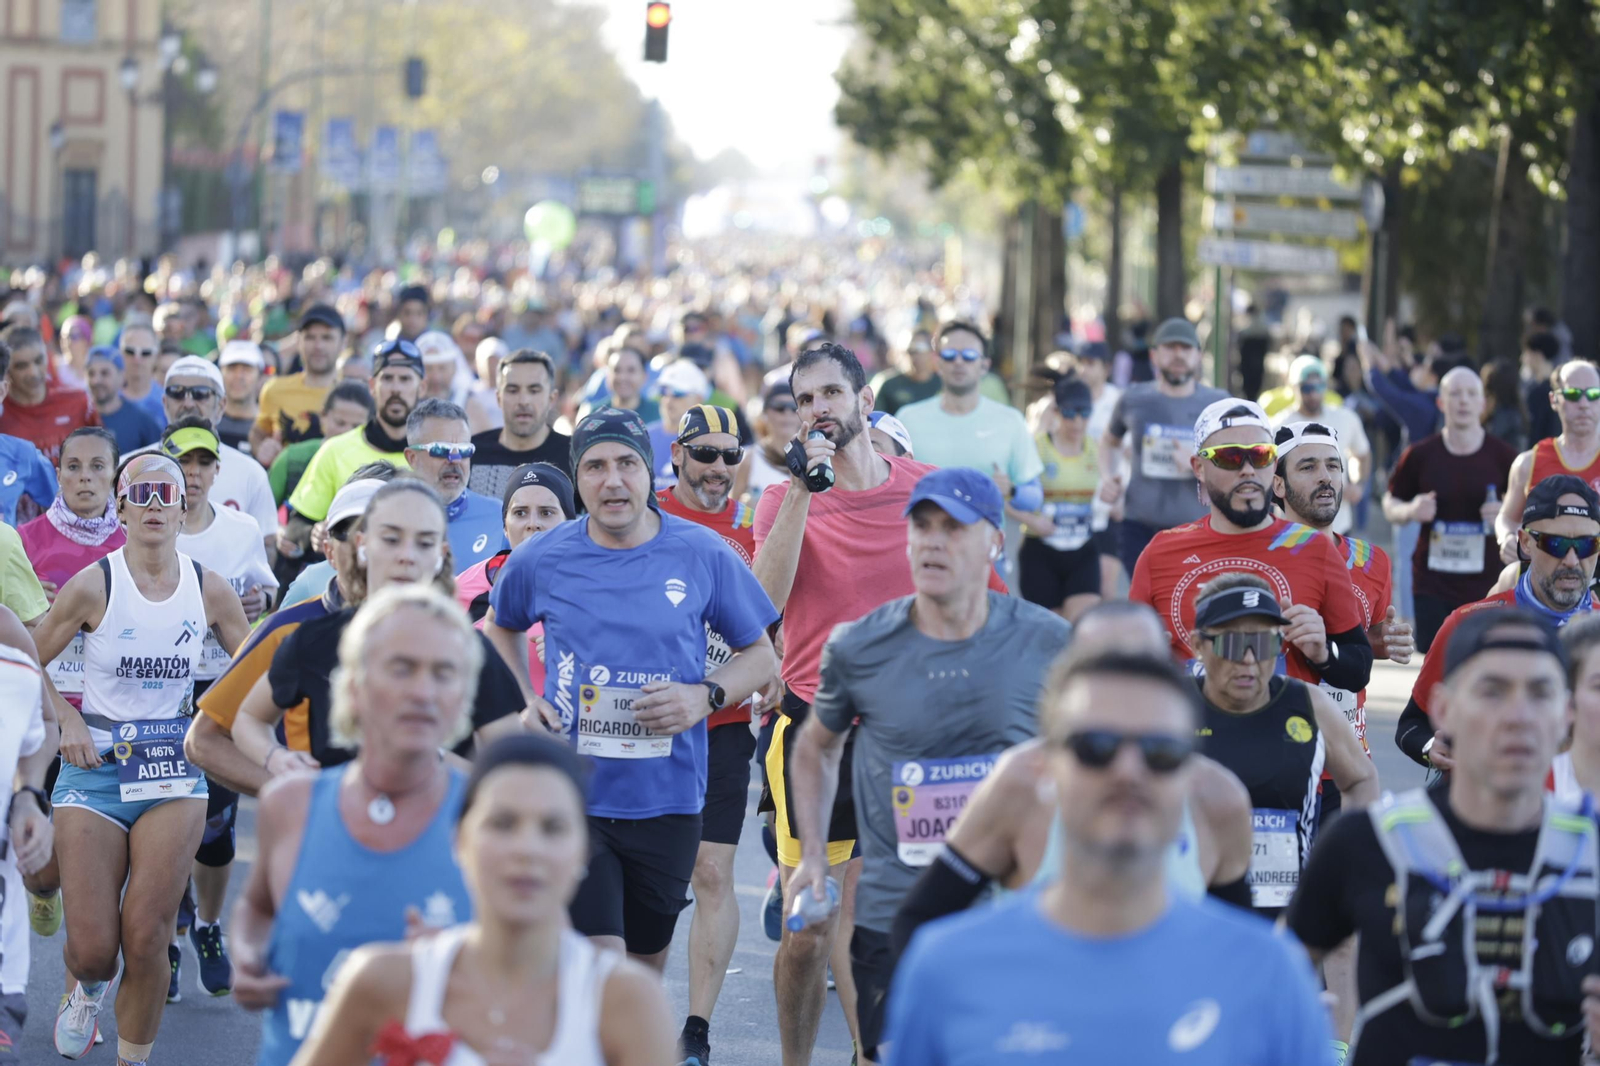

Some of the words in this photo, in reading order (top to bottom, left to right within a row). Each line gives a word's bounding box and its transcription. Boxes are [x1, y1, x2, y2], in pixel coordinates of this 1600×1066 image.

[120, 654, 190, 669] MARATÓN
[116, 667, 133, 678] DE
[136, 668, 190, 679] SEVILLA
[616, 671, 671, 684] ZURICH
[142, 681, 164, 690] 2025
[142, 724, 184, 735] ZURICH
[579, 719, 641, 736] RICARDO
[144, 746, 175, 758] 14676
[138, 760, 187, 780] ADELE
[929, 762, 994, 781] ZURICH
